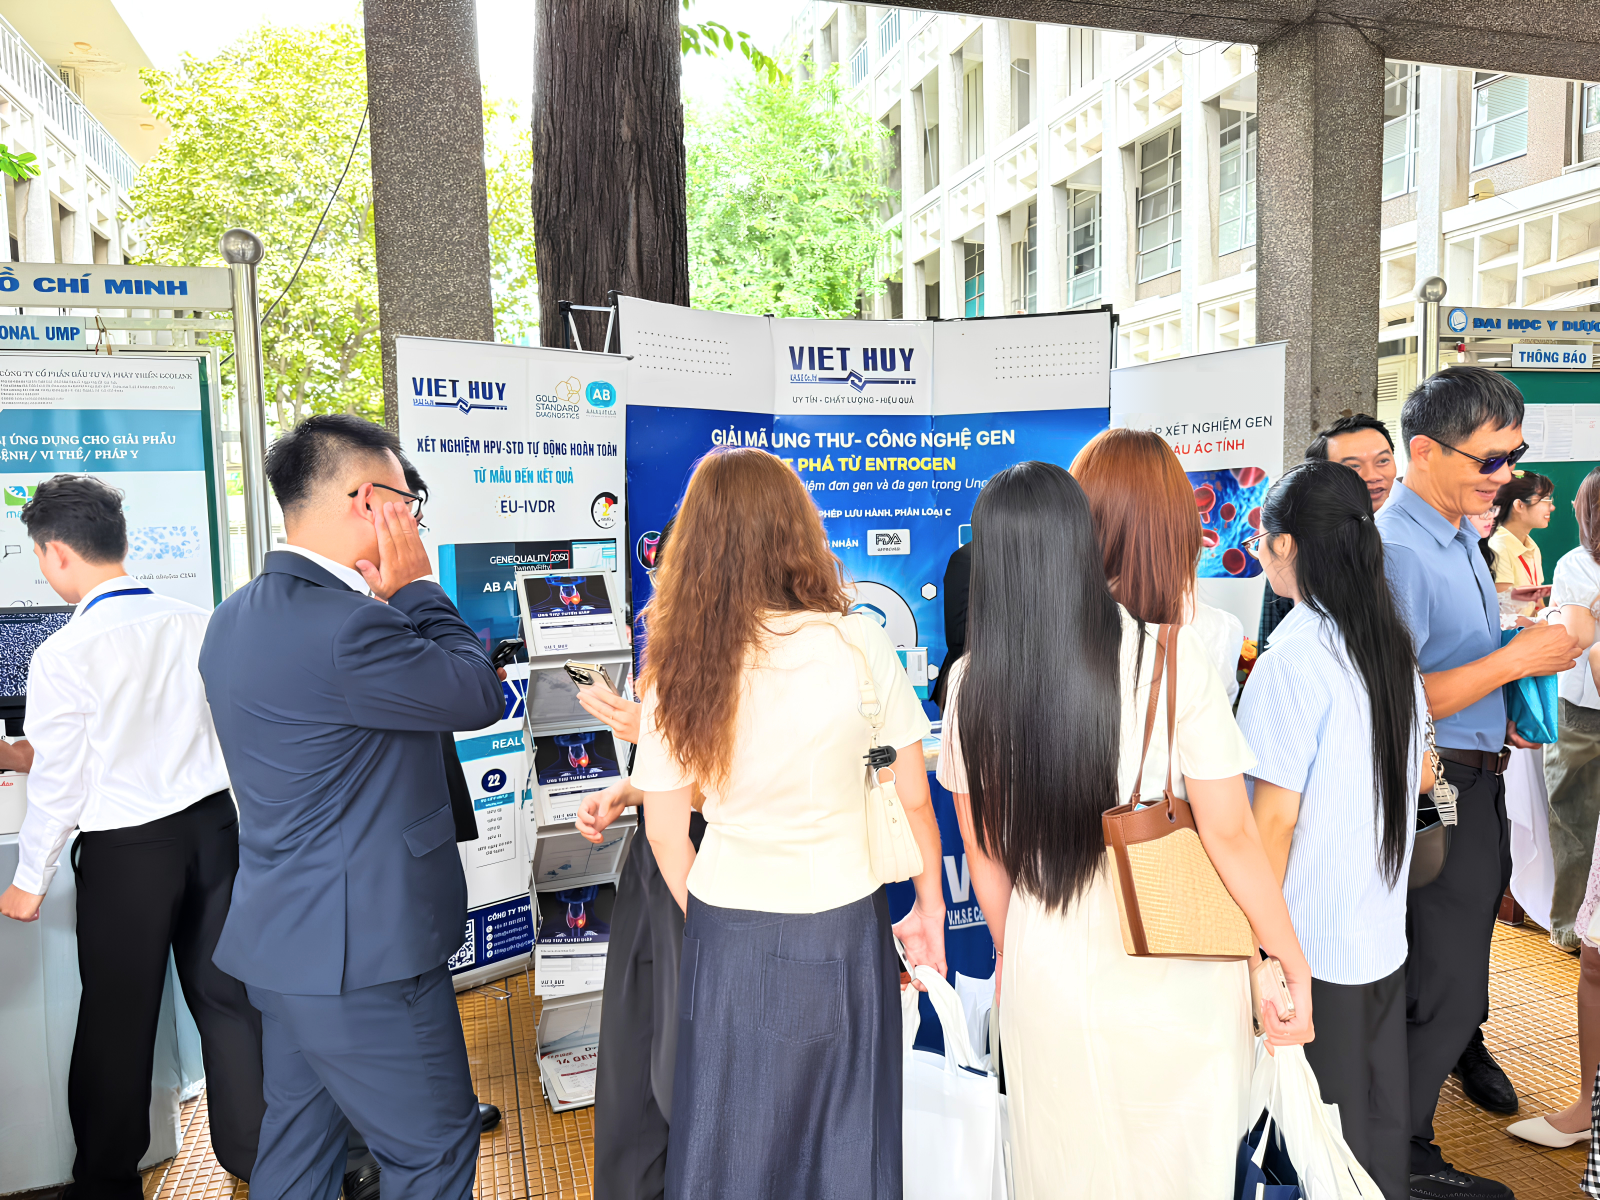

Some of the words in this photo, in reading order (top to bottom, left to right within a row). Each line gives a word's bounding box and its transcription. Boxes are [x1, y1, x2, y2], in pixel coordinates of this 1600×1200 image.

[33, 273, 92, 294] CHÍ
[104, 279, 188, 296] MINH
[1473, 318, 1501, 332] ĐẠI
[1508, 319, 1542, 333] HỌC
[1547, 320, 1558, 331] Y
[46, 326, 80, 341] UMP
[788, 346, 850, 371] VIET
[862, 348, 914, 372] HUY
[1518, 348, 1560, 362] THÔNG
[1562, 350, 1587, 364] BÁO
[412, 376, 460, 398] VIET
[468, 380, 506, 400] HUY
[592, 388, 610, 401] AB
[536, 394, 558, 402] GOLD
[536, 403, 580, 412] STANDARD
[1166, 422, 1188, 436] XÉT
[1192, 416, 1241, 434] NGHIỆM
[1245, 416, 1272, 428] GEN
[10, 432, 38, 445] ỨNG
[42, 436, 79, 446] DỤNG
[82, 436, 110, 444] CHO
[112, 433, 139, 444] GIẢI
[712, 425, 742, 446] GIẢI
[745, 428, 768, 448] MÃ
[772, 432, 811, 448] UNG
[866, 428, 916, 448] CÔNG
[921, 428, 972, 450] NGHỆ
[976, 430, 1016, 446] GEN
[417, 436, 436, 452] XÉT
[440, 436, 480, 456] NGHIỆM
[484, 440, 524, 454] HPV-STD
[527, 441, 540, 458] TỰ
[544, 440, 567, 458] ĐỘNG
[570, 440, 594, 456] HOÀN
[596, 442, 617, 456] TOÀN
[1170, 442, 1190, 455] ÁU
[1194, 440, 1212, 454] ÁC
[1216, 437, 1244, 452] TÍNH
[40, 450, 54, 460] VI
[95, 448, 128, 460] PHÁP
[130, 450, 139, 459] Y
[798, 454, 834, 472] PHÁ
[838, 454, 862, 472] TỪ
[865, 457, 956, 471] ENTROGEN
[474, 466, 486, 484] TỪ
[490, 466, 512, 484] MẪU
[828, 480, 850, 491] đơn
[852, 482, 873, 492] gen
[876, 478, 888, 490] và
[892, 480, 904, 490] đa
[908, 480, 928, 492] gen
[932, 479, 962, 490] trong
[500, 500, 556, 513] EU-IVDR
[818, 508, 842, 518] PHÉP
[844, 509, 862, 518] LƯU
[865, 508, 892, 517] HÀNH,
[894, 508, 920, 516] PHÂN
[922, 508, 942, 518] LOẠI
[832, 538, 858, 549] NHẬN
[876, 532, 902, 546] FDA
[490, 554, 550, 565] GENEQUALITY
[483, 582, 500, 592] AB
[488, 774, 500, 788] 22
[508, 908, 516, 916] TY
[947, 908, 973, 925] V.H.S.E
[573, 1052, 598, 1062] GEN
